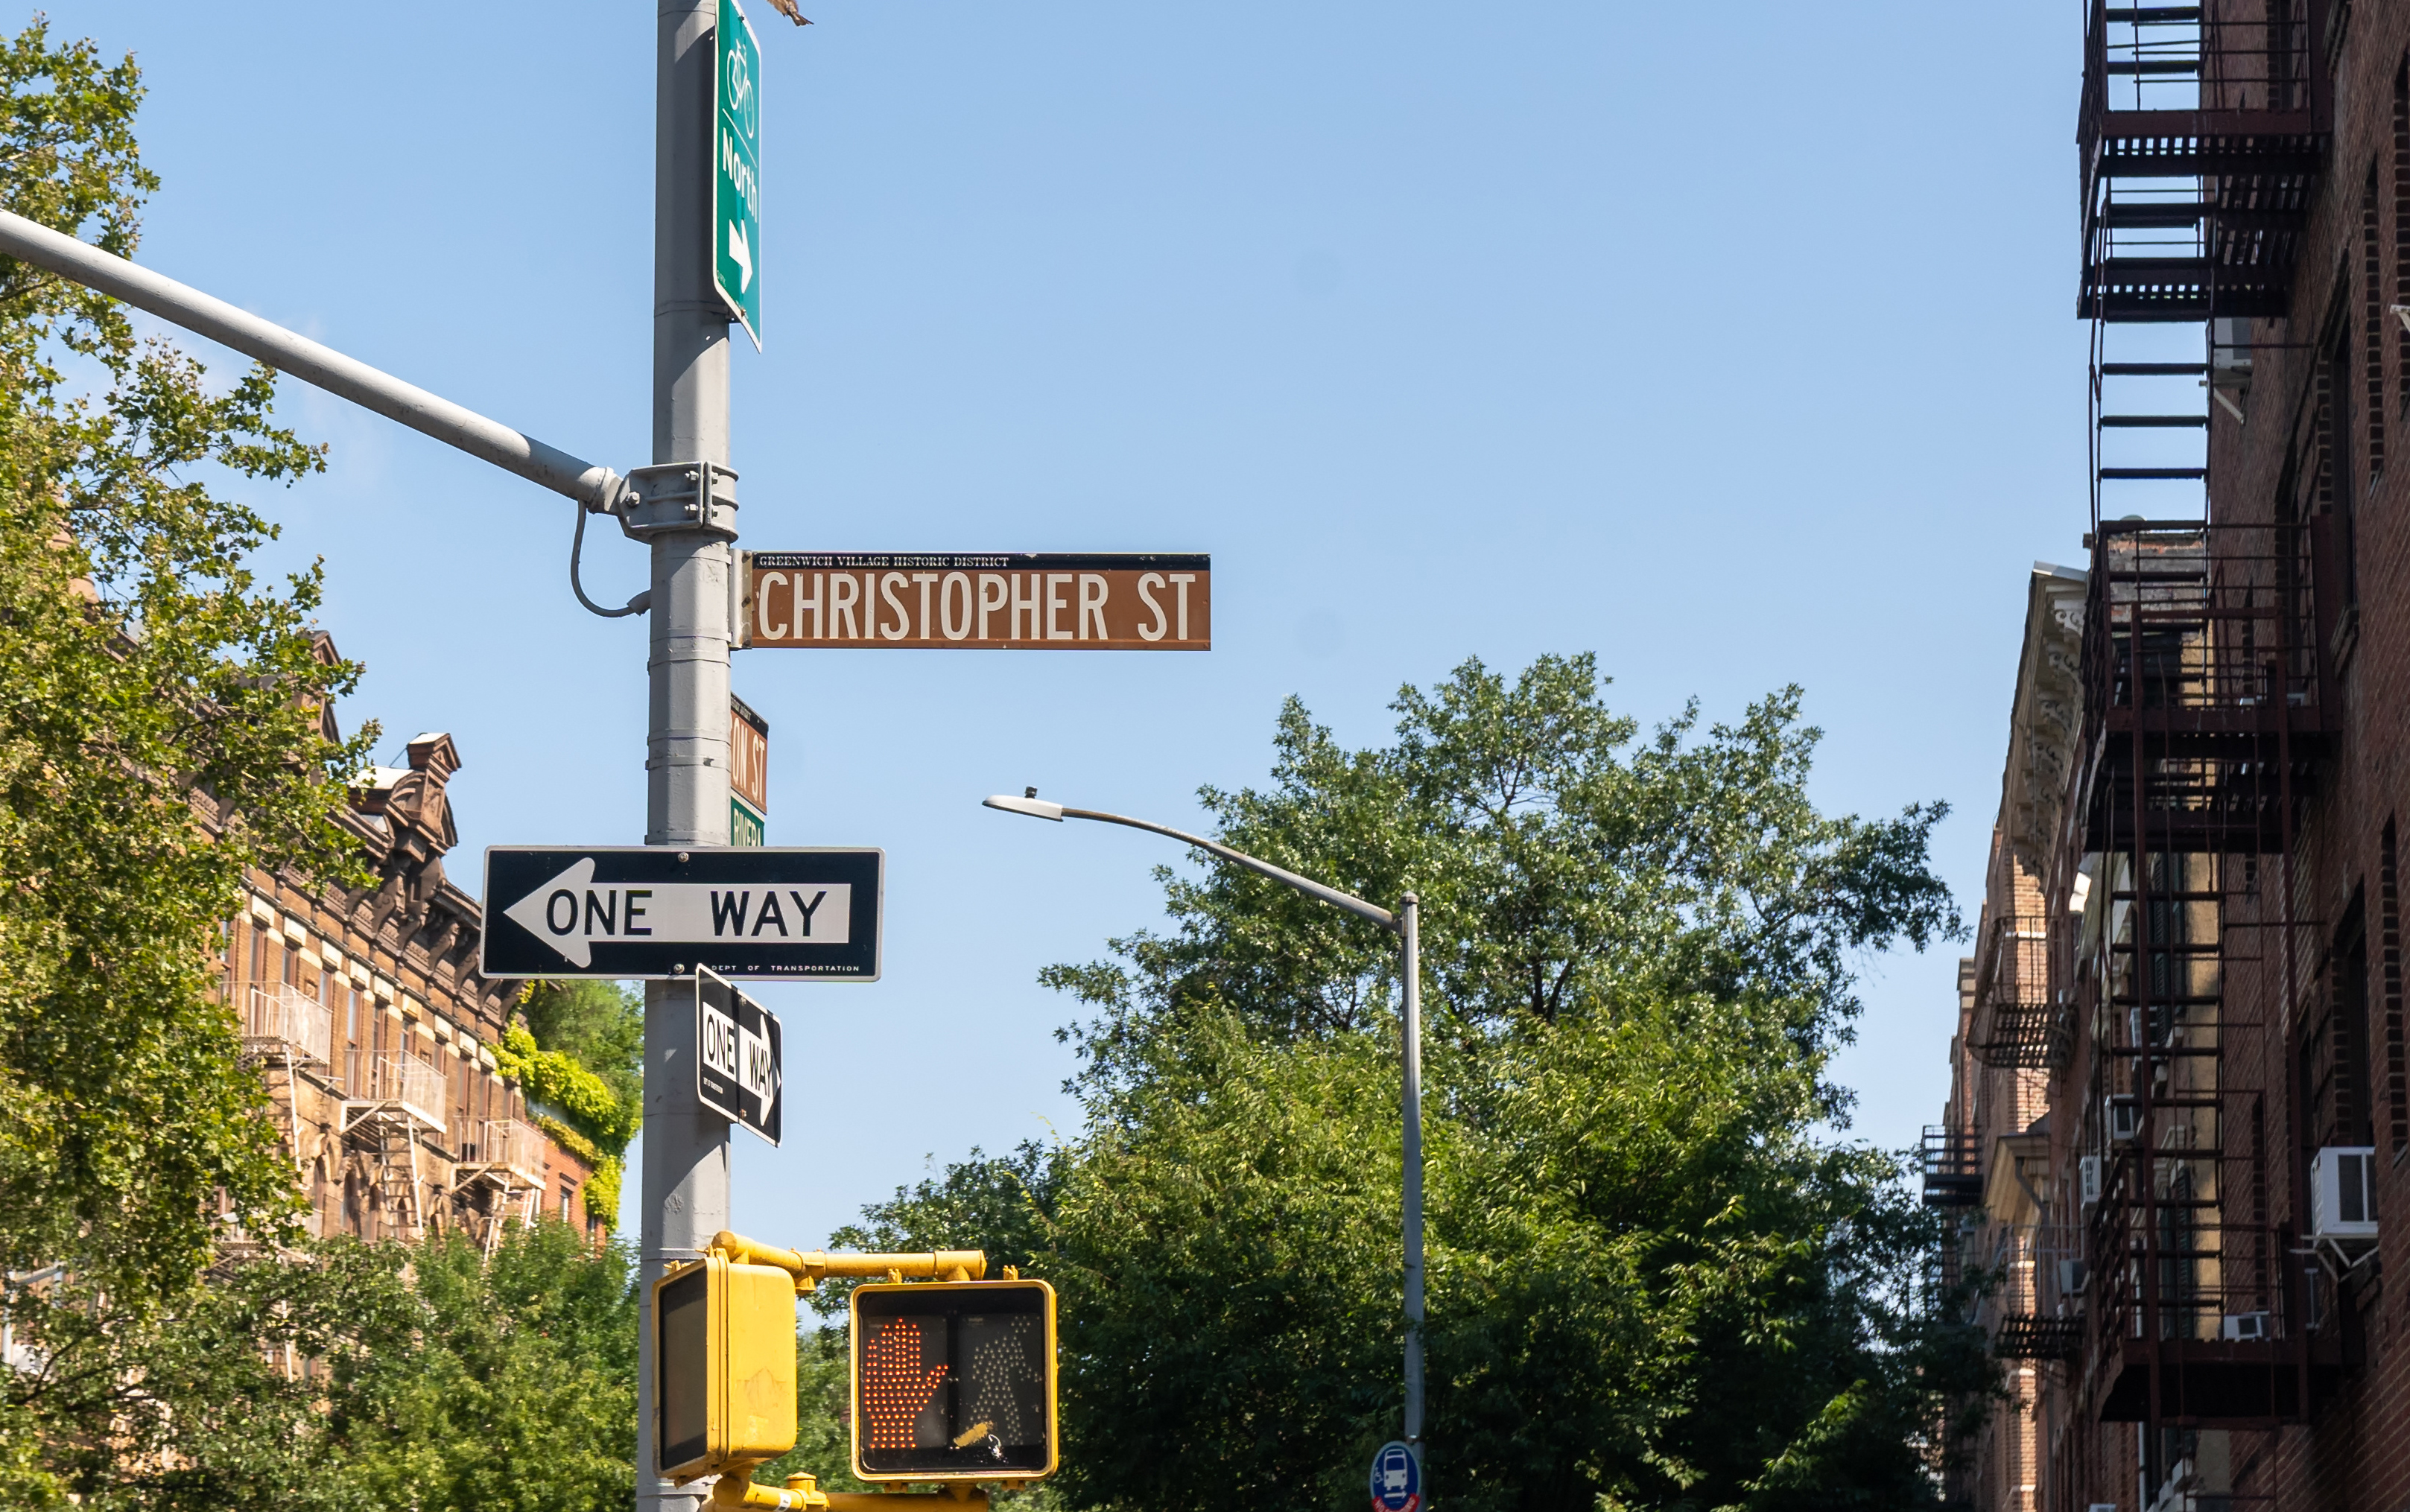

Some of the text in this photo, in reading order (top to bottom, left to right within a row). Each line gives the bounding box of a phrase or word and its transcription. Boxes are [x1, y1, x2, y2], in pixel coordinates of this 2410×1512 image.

[723, 127, 757, 223] North
[759, 556, 1009, 568] GREENWICH VILLAGE HISTORIC DISTRICT
[758, 571, 1196, 641] CHRISTOPHER ST
[730, 713, 765, 804] ON ST
[546, 889, 827, 937] ONE WAY
[707, 1014, 773, 1098] ONE WAY
